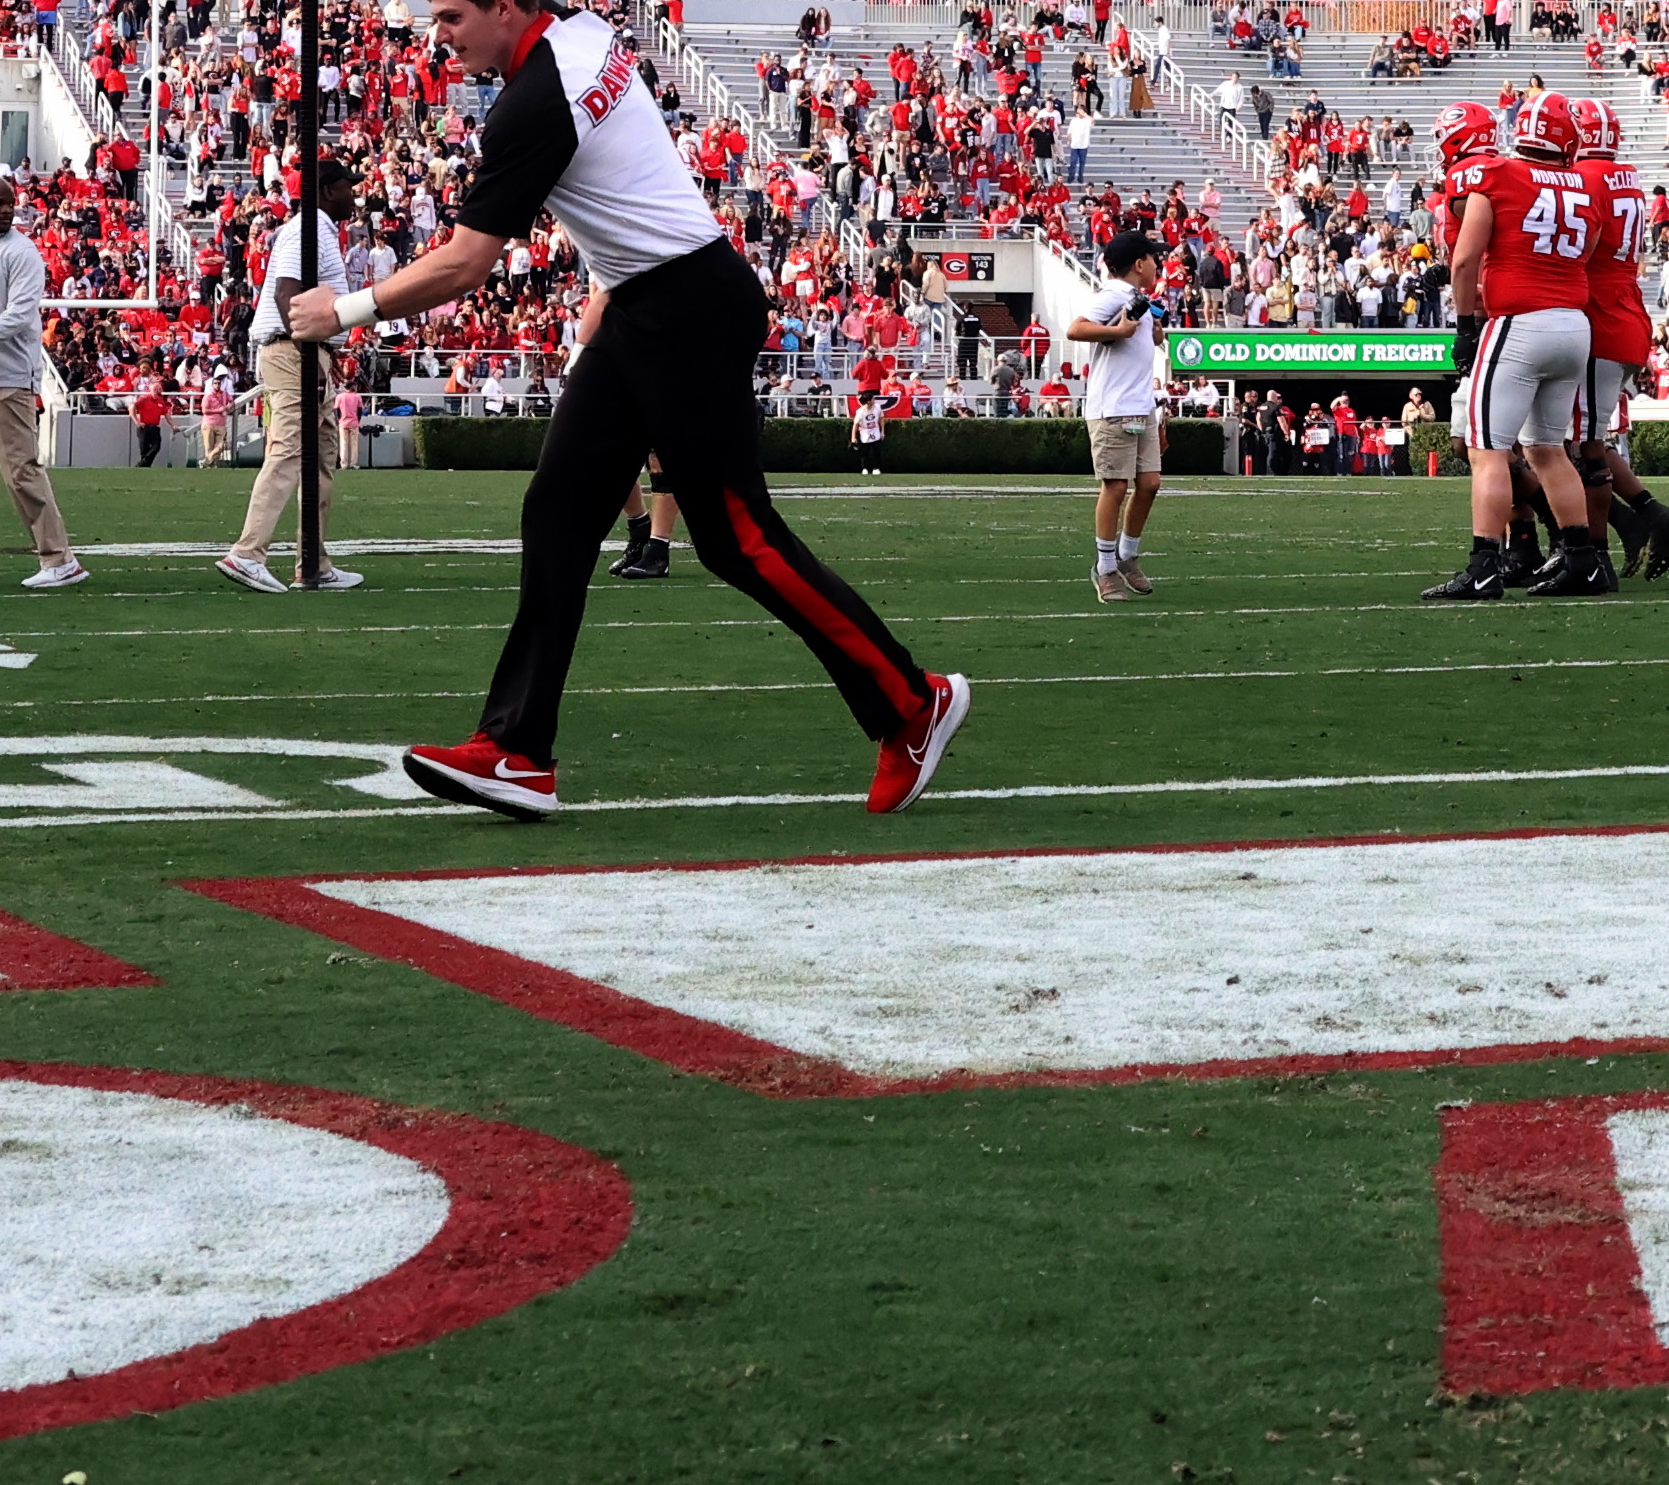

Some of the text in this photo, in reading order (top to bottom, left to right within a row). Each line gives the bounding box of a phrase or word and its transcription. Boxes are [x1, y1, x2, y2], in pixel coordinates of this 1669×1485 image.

[1530, 168, 1583, 189] NORTON
[1523, 188, 1591, 259] 45
[975, 261, 988, 269] 143
[1209, 342, 1445, 362] OLD DOMINION FREIGHT
